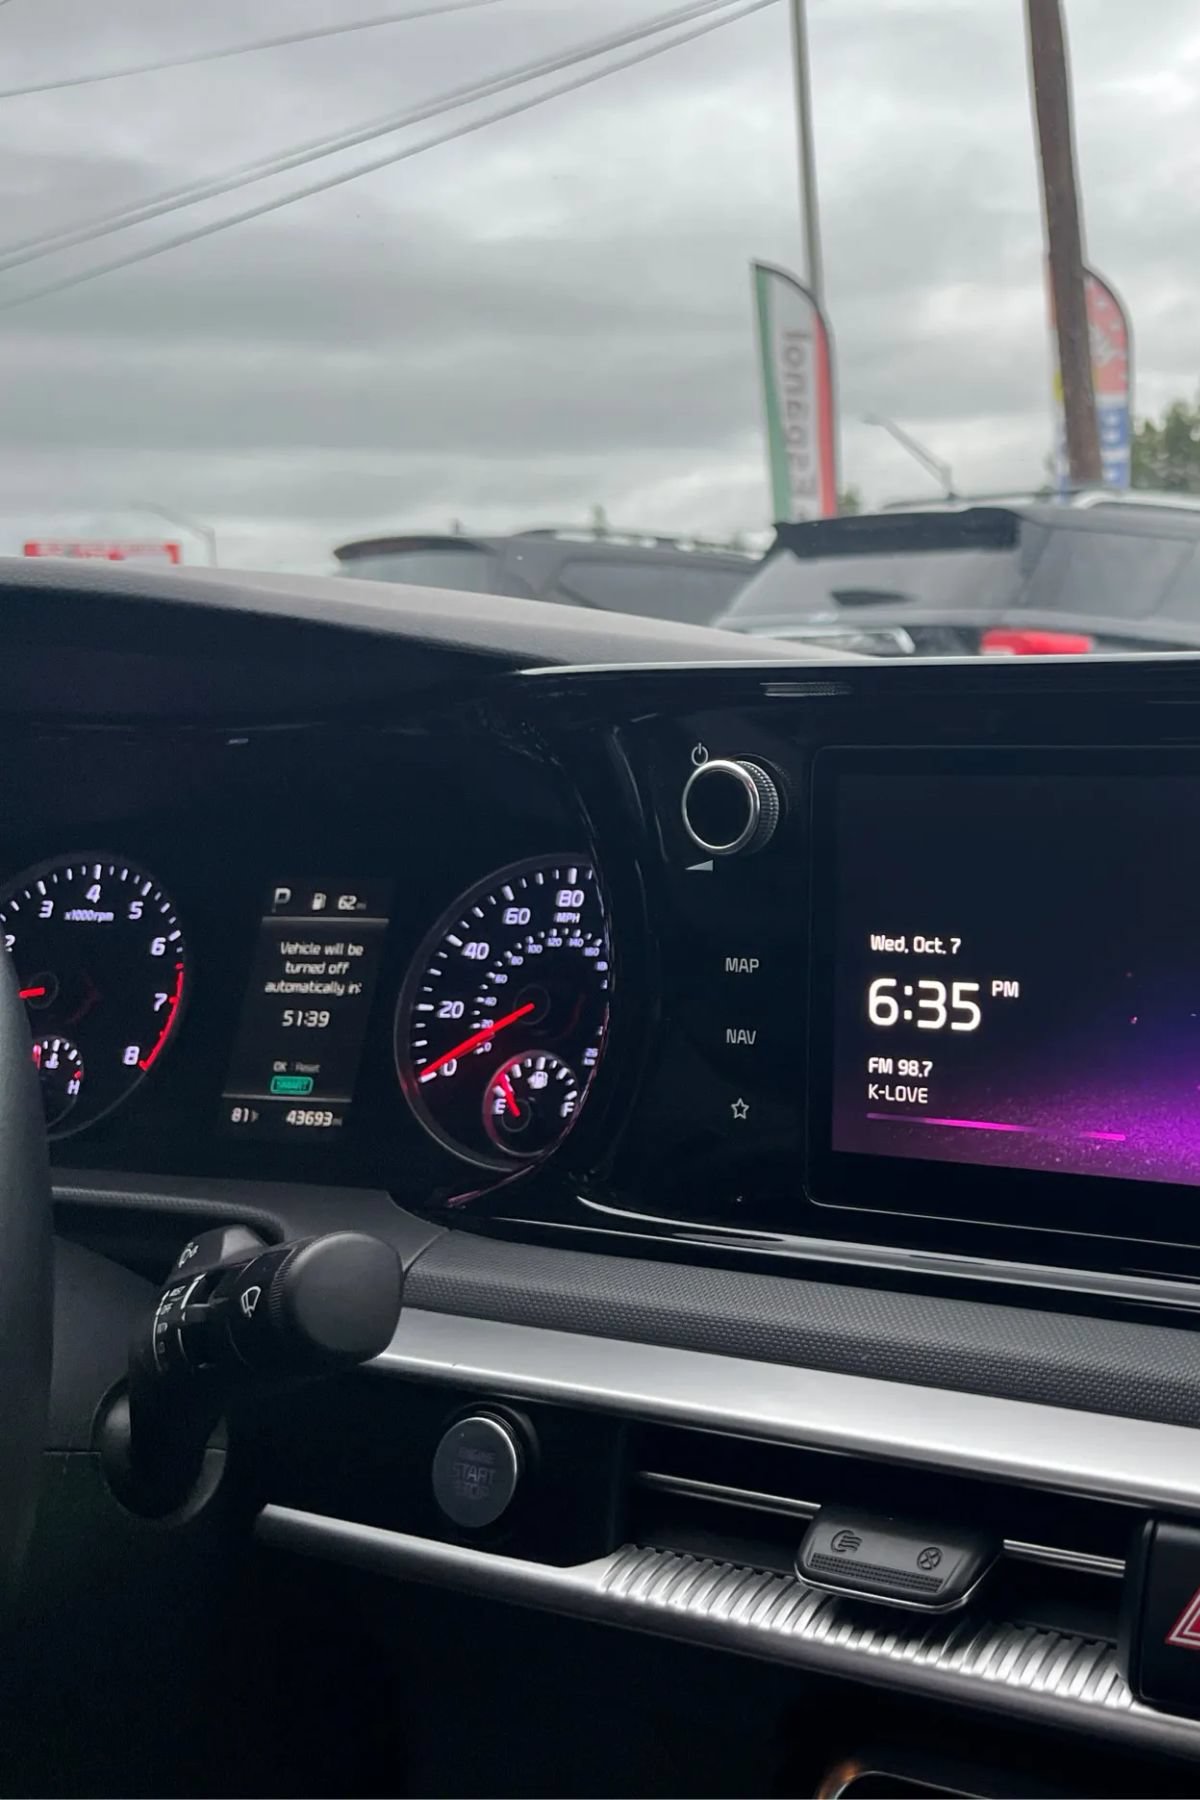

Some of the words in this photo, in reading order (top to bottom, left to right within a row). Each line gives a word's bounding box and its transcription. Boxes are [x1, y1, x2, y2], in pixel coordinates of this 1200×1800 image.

[85, 884, 101, 903] 4
[273, 888, 291, 913] P
[556, 890, 584, 907] 80
[39, 901, 53, 918] 3
[128, 902, 143, 919] 5
[503, 908, 530, 925] 60
[554, 912, 580, 923] MPH
[151, 937, 166, 956] 6
[280, 942, 321, 956] Vehicle
[324, 943, 344, 956] will
[347, 943, 364, 956] be
[462, 943, 489, 960] 40
[912, 936, 947, 955] Oct.
[950, 938, 962, 954] 7
[285, 961, 325, 974] turned
[328, 962, 350, 974] off
[725, 957, 760, 974] MAP
[265, 980, 345, 996] automatically
[154, 993, 167, 1011] 7
[437, 1001, 464, 1018] 20
[868, 977, 982, 1032] 6:35
[992, 980, 1020, 998] PM
[282, 1010, 330, 1027] 51:39
[726, 1028, 757, 1045] NAV
[123, 1046, 139, 1065] 8
[868, 1057, 894, 1075] FM
[898, 1058, 934, 1078] 98.7
[67, 1080, 80, 1095] H
[868, 1083, 929, 1104] K-LOVE
[493, 1099, 506, 1114] E
[561, 1102, 575, 1117] F
